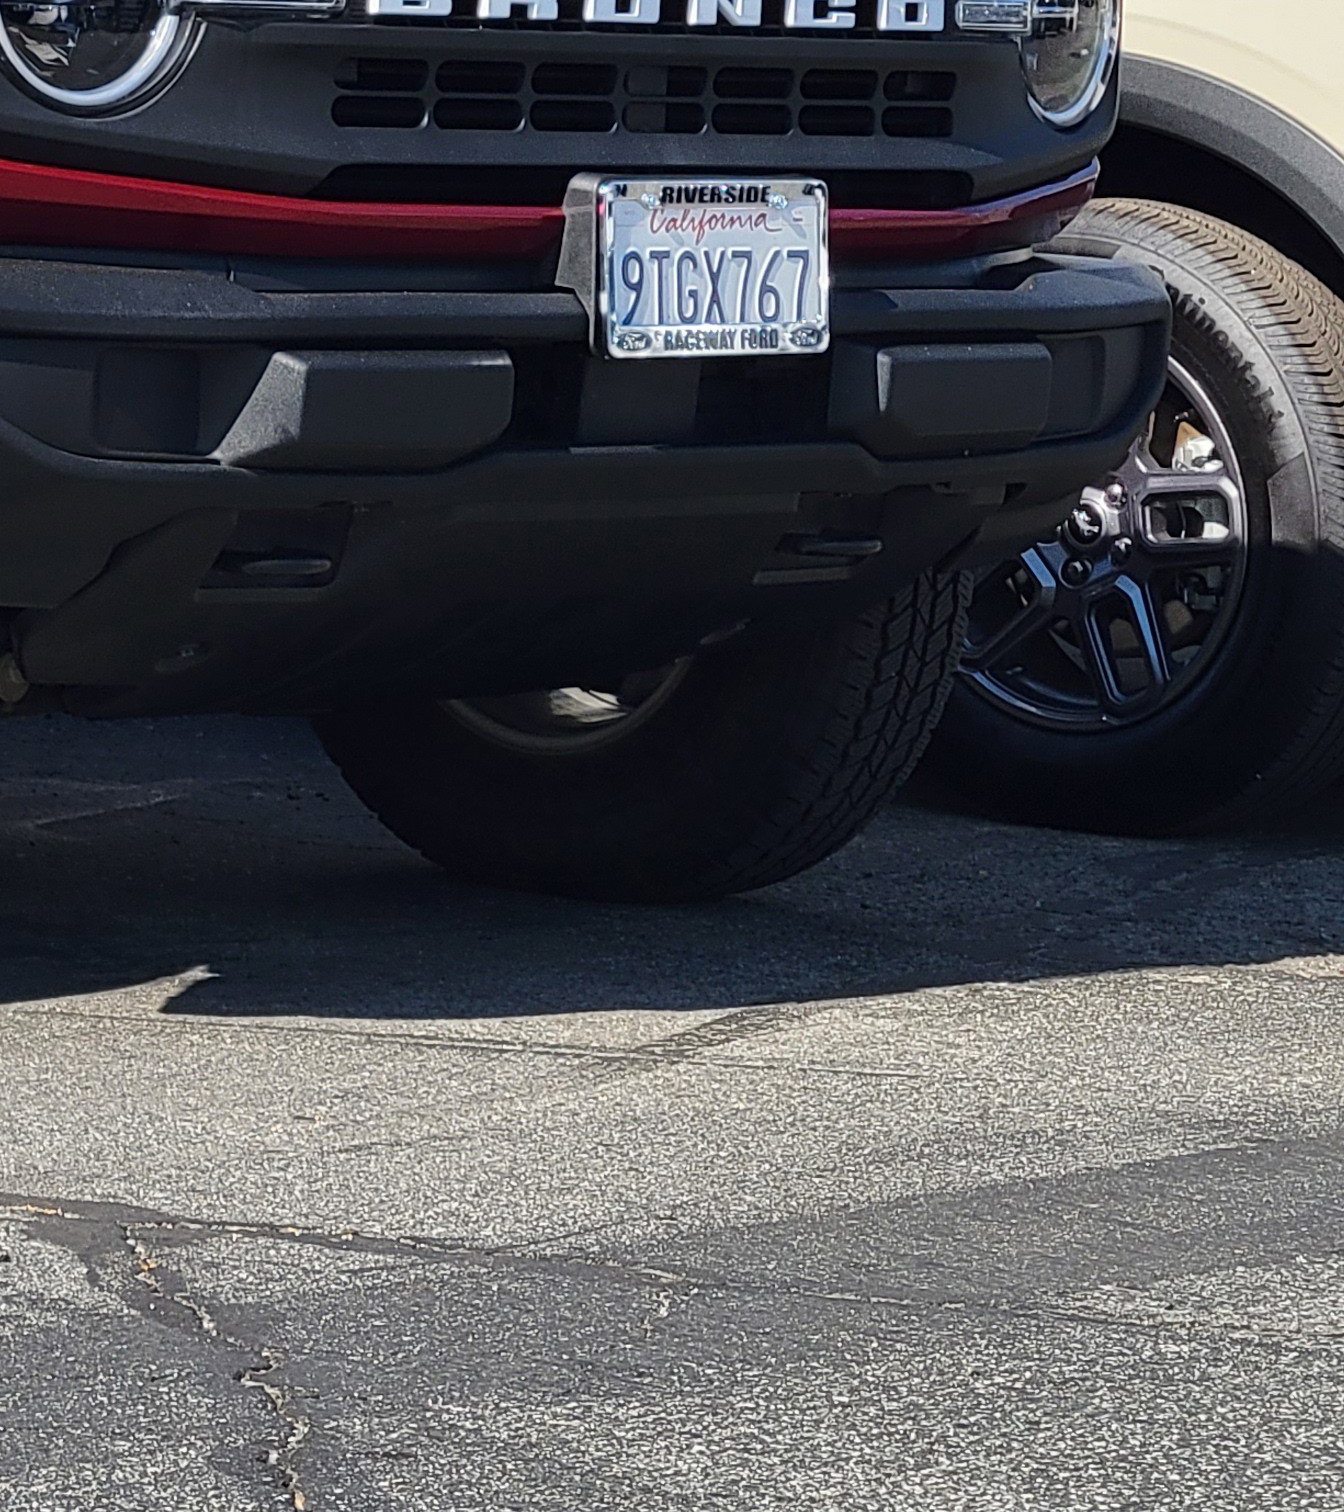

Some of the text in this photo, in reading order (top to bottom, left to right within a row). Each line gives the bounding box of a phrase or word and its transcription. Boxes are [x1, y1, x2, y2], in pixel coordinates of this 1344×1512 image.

[659, 185, 773, 206] RIVERSIDE
[648, 206, 784, 246] California
[621, 249, 811, 326] 9TGX767
[663, 330, 737, 352] RACEWAY
[740, 328, 781, 350] FORD
[1162, 277, 1286, 434] ntinental
